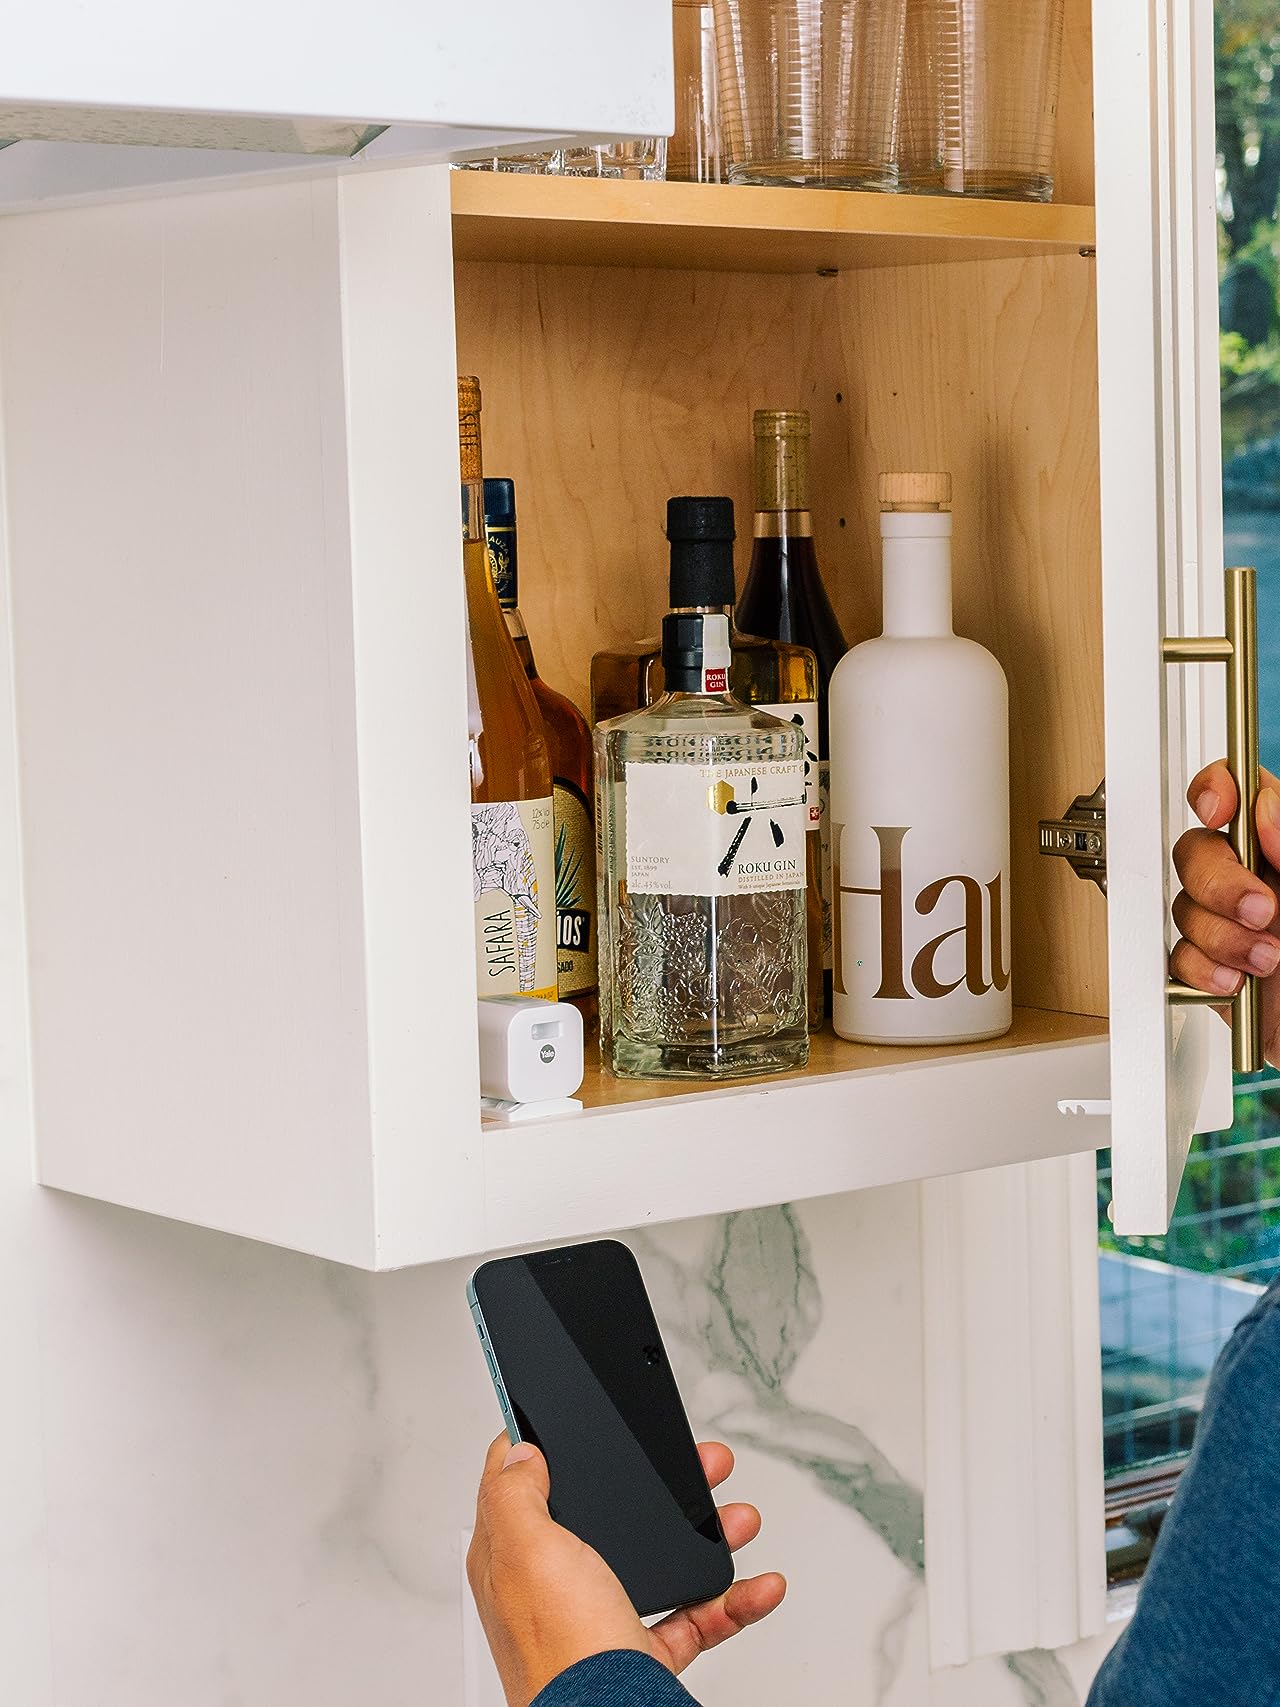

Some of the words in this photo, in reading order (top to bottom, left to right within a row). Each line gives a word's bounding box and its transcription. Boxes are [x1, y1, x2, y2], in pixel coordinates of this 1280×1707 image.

[706, 673, 726, 681] ROKU
[725, 767, 767, 779] JAPANESE
[769, 765, 798, 775] CRAFT
[631, 855, 670, 864] SUNTORY
[738, 862, 770, 874] ROKU
[774, 859, 796, 871] GIN
[785, 871, 804, 880] JAPAN
[483, 908, 517, 978] SAFARA
